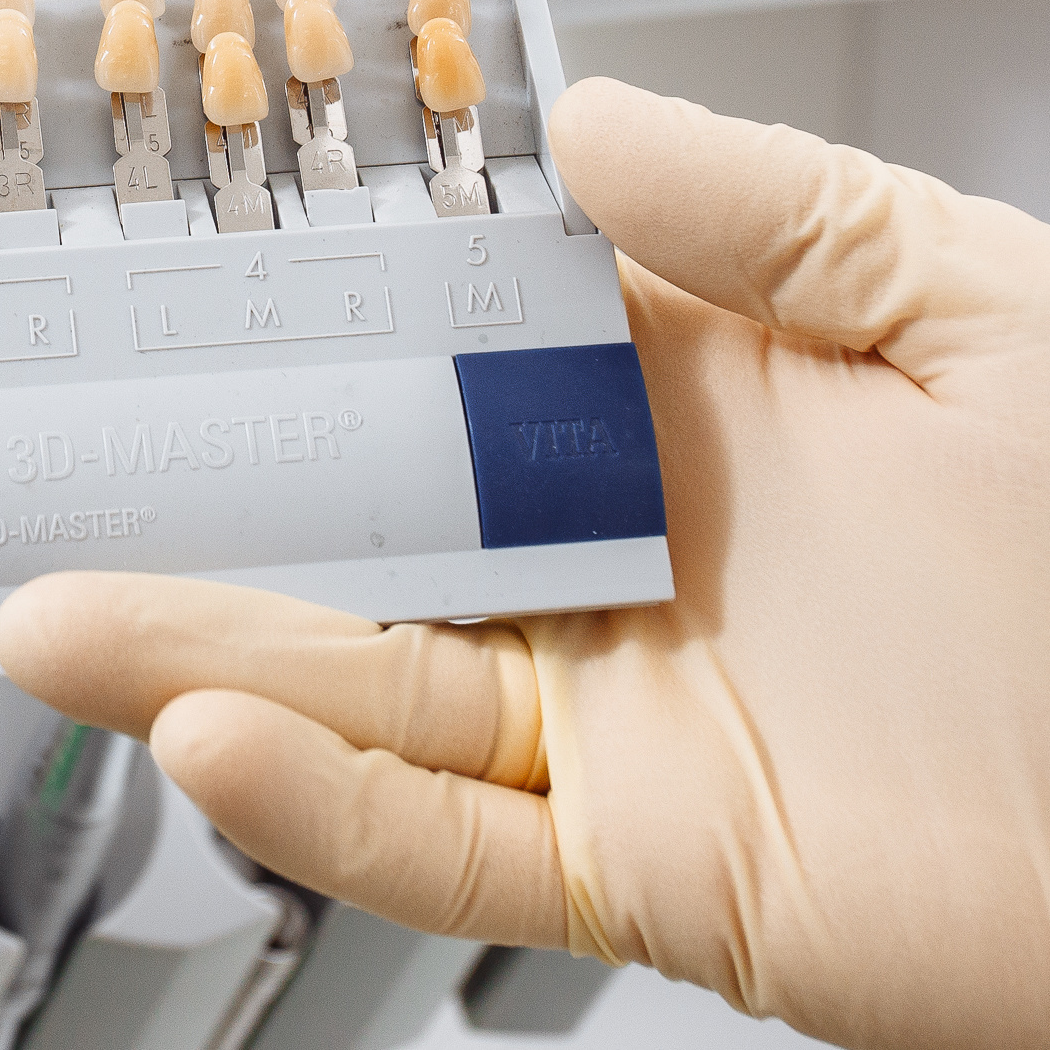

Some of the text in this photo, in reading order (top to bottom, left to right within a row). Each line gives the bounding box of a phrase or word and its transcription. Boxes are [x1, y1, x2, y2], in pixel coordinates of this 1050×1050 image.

[310, 149, 347, 174] 4R
[127, 165, 158, 191] 4L
[226, 191, 265, 216] 4M
[440, 181, 483, 209] 5M
[244, 250, 268, 281] 4
[466, 234, 489, 266] 5
[159, 290, 367, 336] L M R
[467, 281, 504, 314] M
[28, 313, 50, 346] R
[508, 416, 620, 462] VITA
